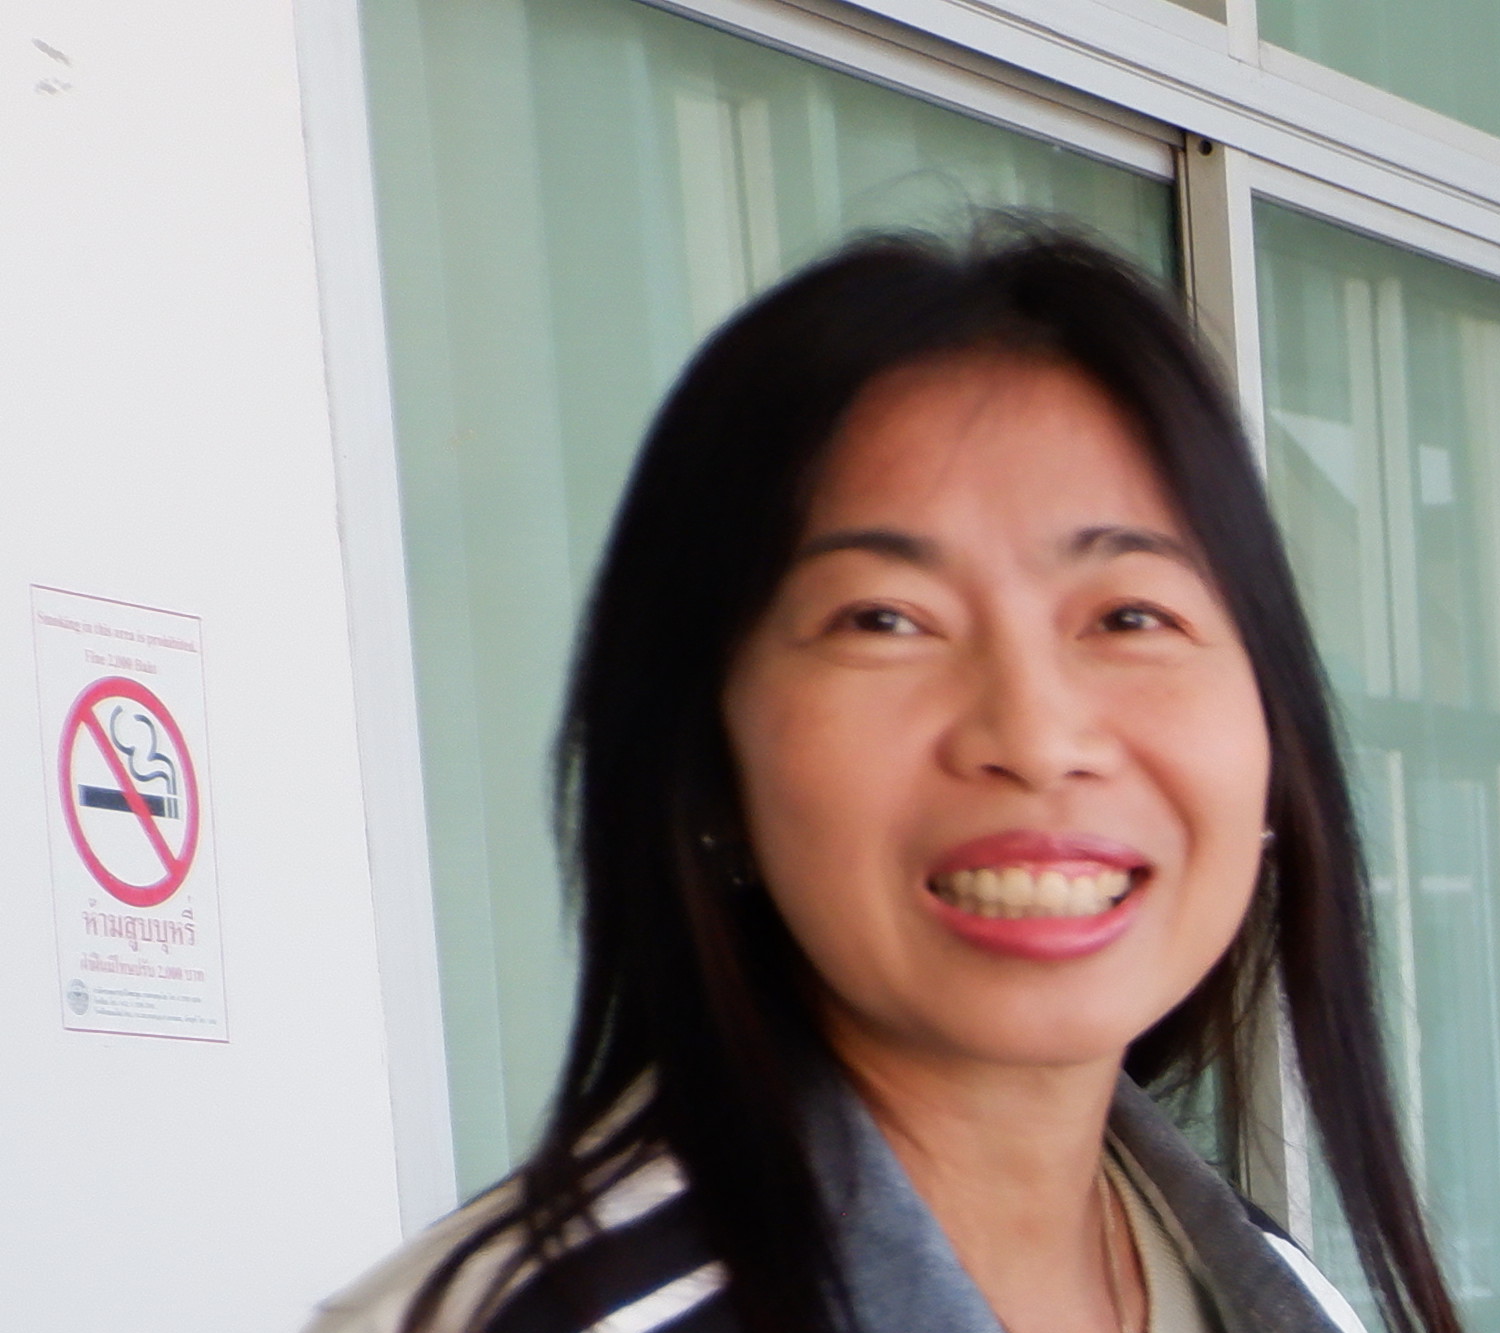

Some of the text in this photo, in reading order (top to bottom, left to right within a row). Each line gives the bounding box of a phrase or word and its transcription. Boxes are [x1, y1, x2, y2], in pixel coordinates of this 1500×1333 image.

[81, 895, 196, 955] ห้ามสูบบุหรี่
